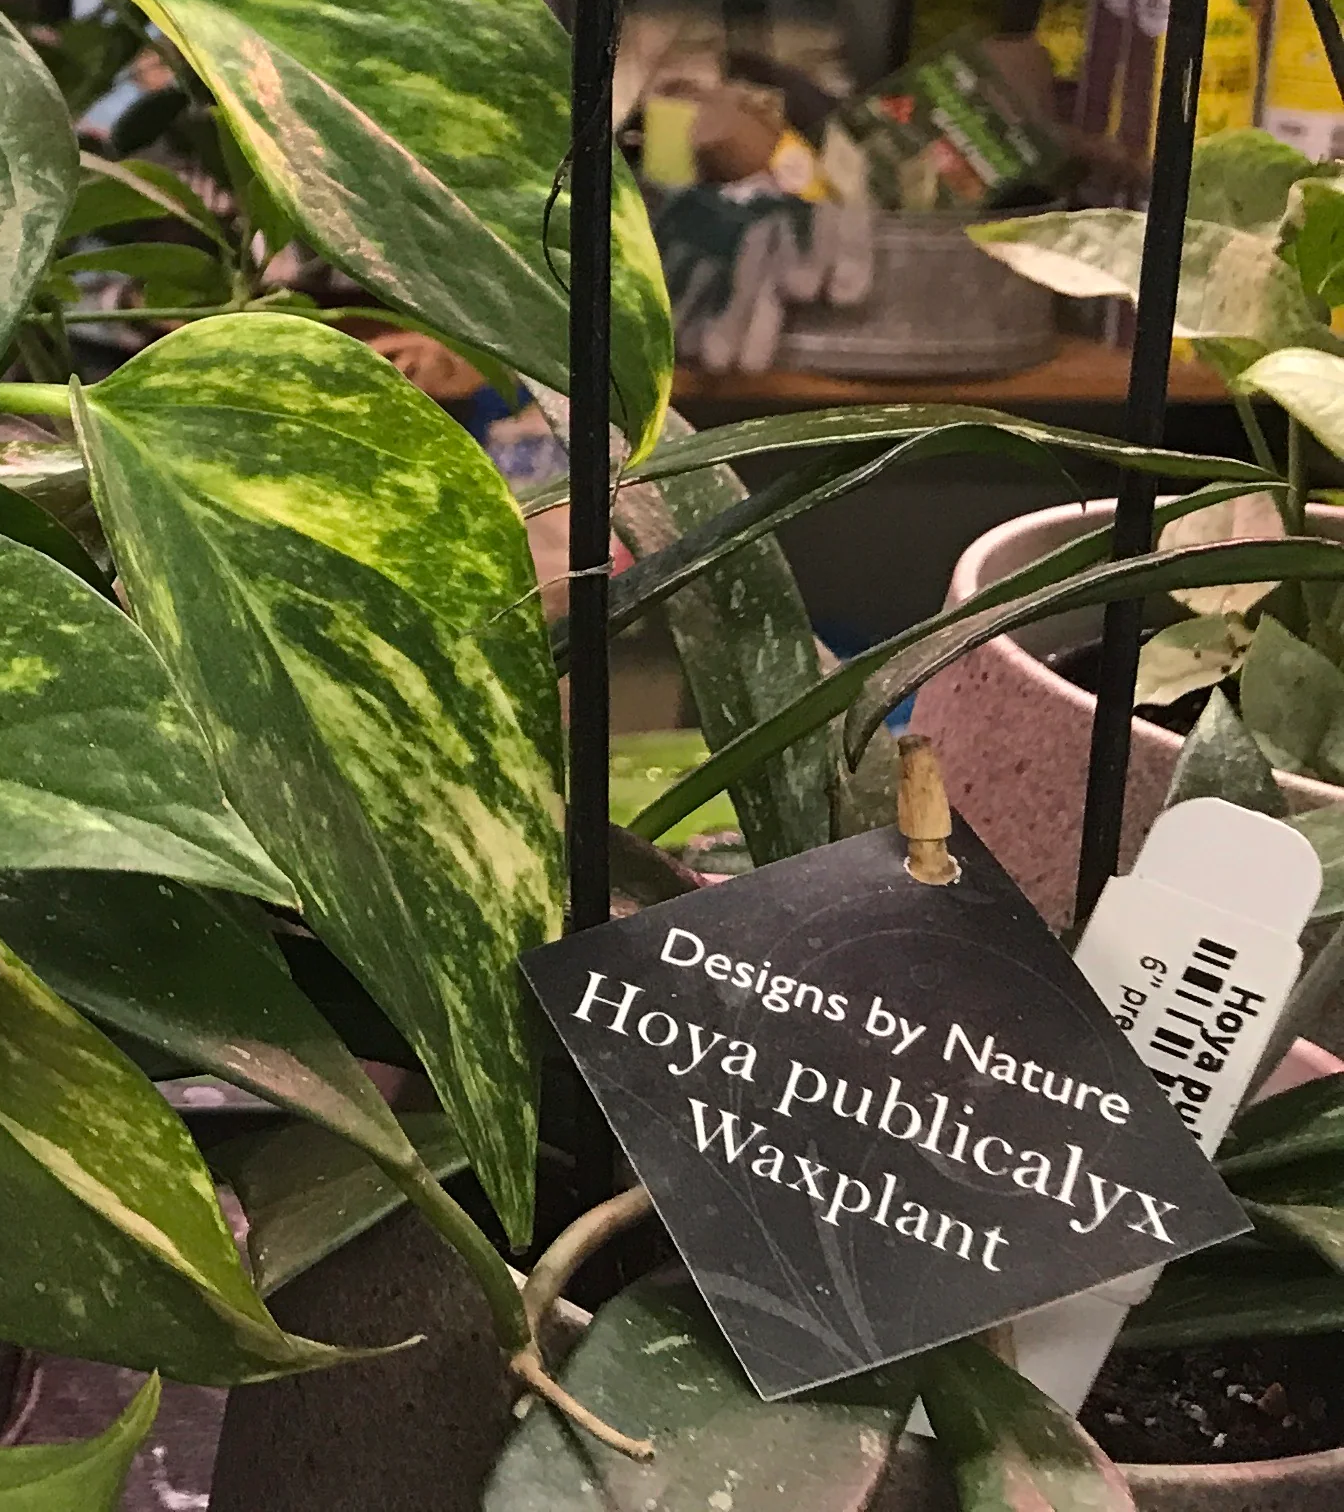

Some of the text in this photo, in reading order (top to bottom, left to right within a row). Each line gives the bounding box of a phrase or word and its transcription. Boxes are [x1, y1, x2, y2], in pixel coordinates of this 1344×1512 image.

[571, 970, 1180, 1246] Hoya publicalyx
[659, 925, 1132, 1126] Designs by Nature
[1193, 984, 1267, 1074] Hoya
[686, 1095, 1012, 1275] Waxplant
